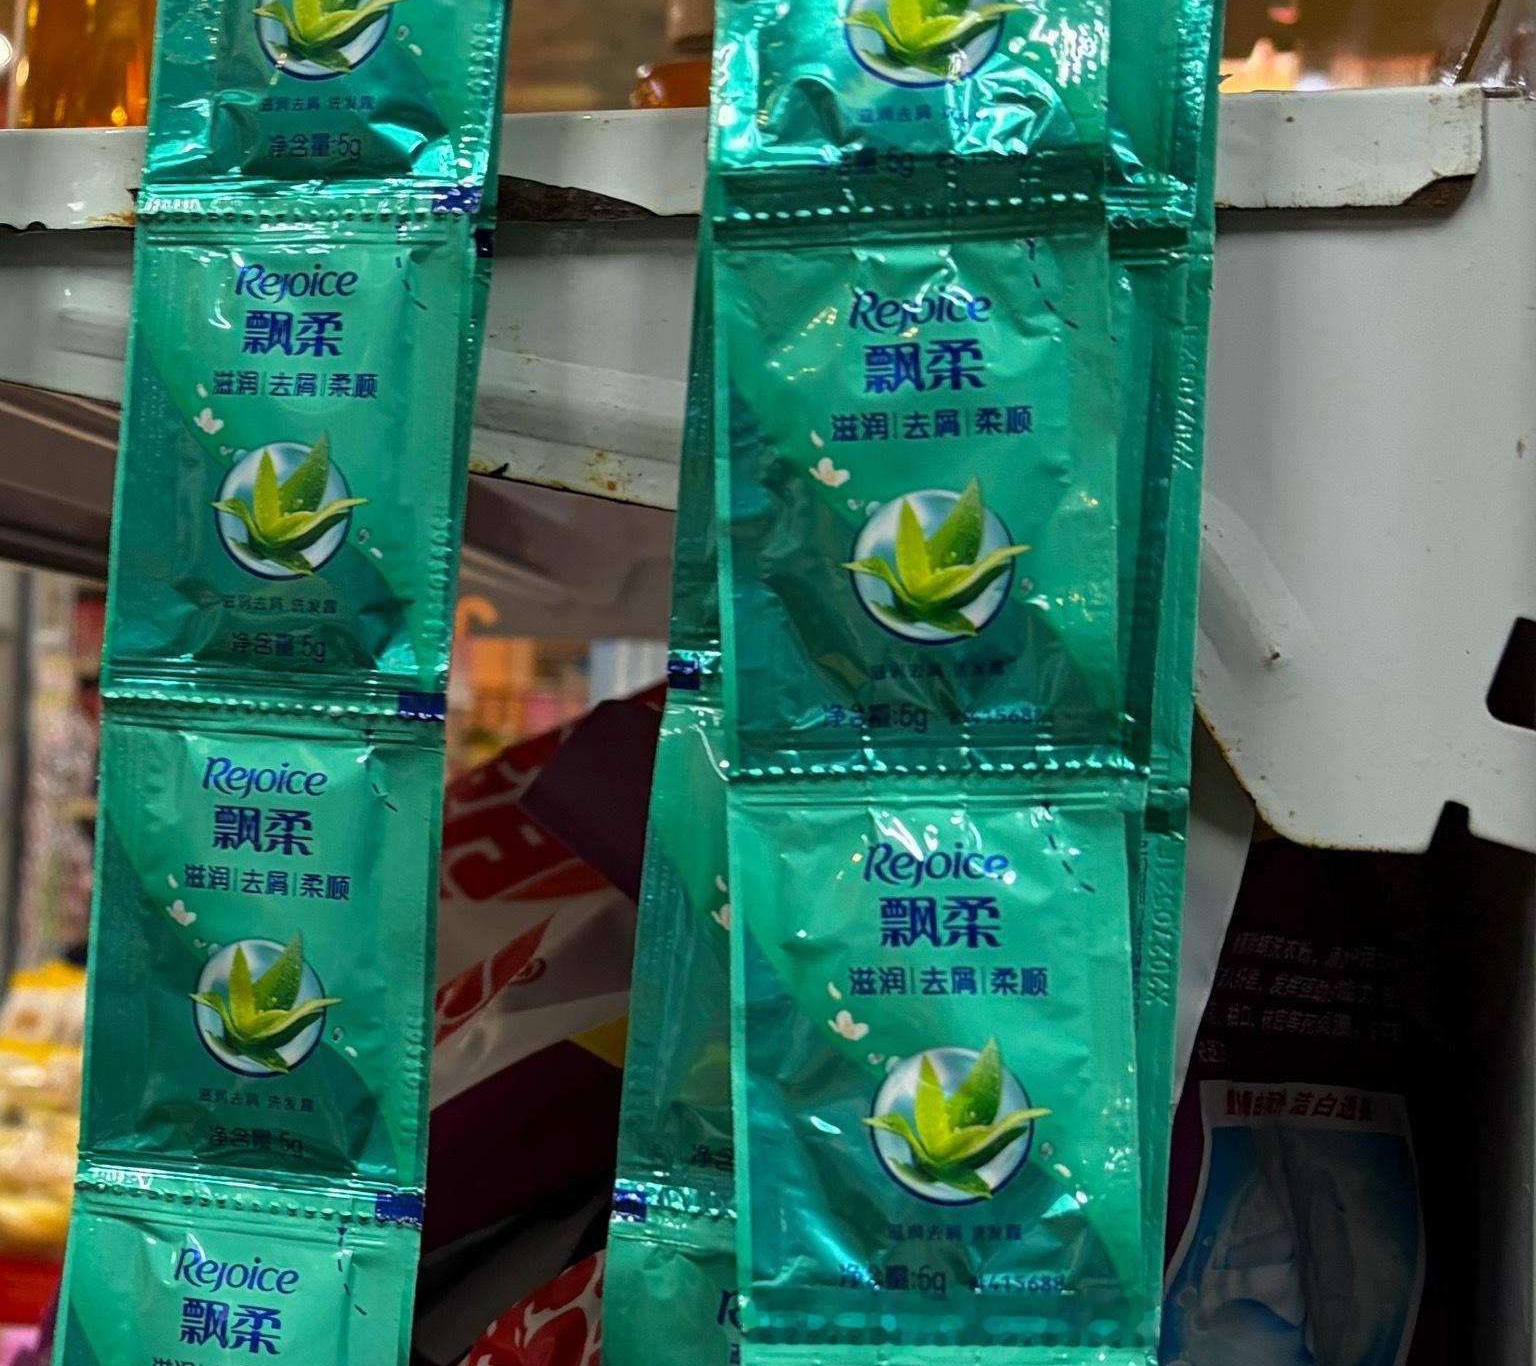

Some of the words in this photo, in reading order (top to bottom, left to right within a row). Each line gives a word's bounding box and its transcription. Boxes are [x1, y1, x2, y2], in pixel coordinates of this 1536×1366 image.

[269, 133, 362, 162] 净含量:5g
[234, 263, 359, 303] Rejoice
[241, 309, 344, 358] 飘柔
[849, 289, 992, 334] Rejoice
[863, 338, 989, 394] 飘柔
[231, 632, 327, 665] 净含量:5g
[202, 756, 328, 800] Rejoice
[211, 804, 314, 858] 飘柔
[863, 841, 1010, 889] Rejoice
[879, 896, 1003, 950] 飘柔
[174, 1247, 301, 1295] Rejoice
[179, 1296, 282, 1356] 飘柔
